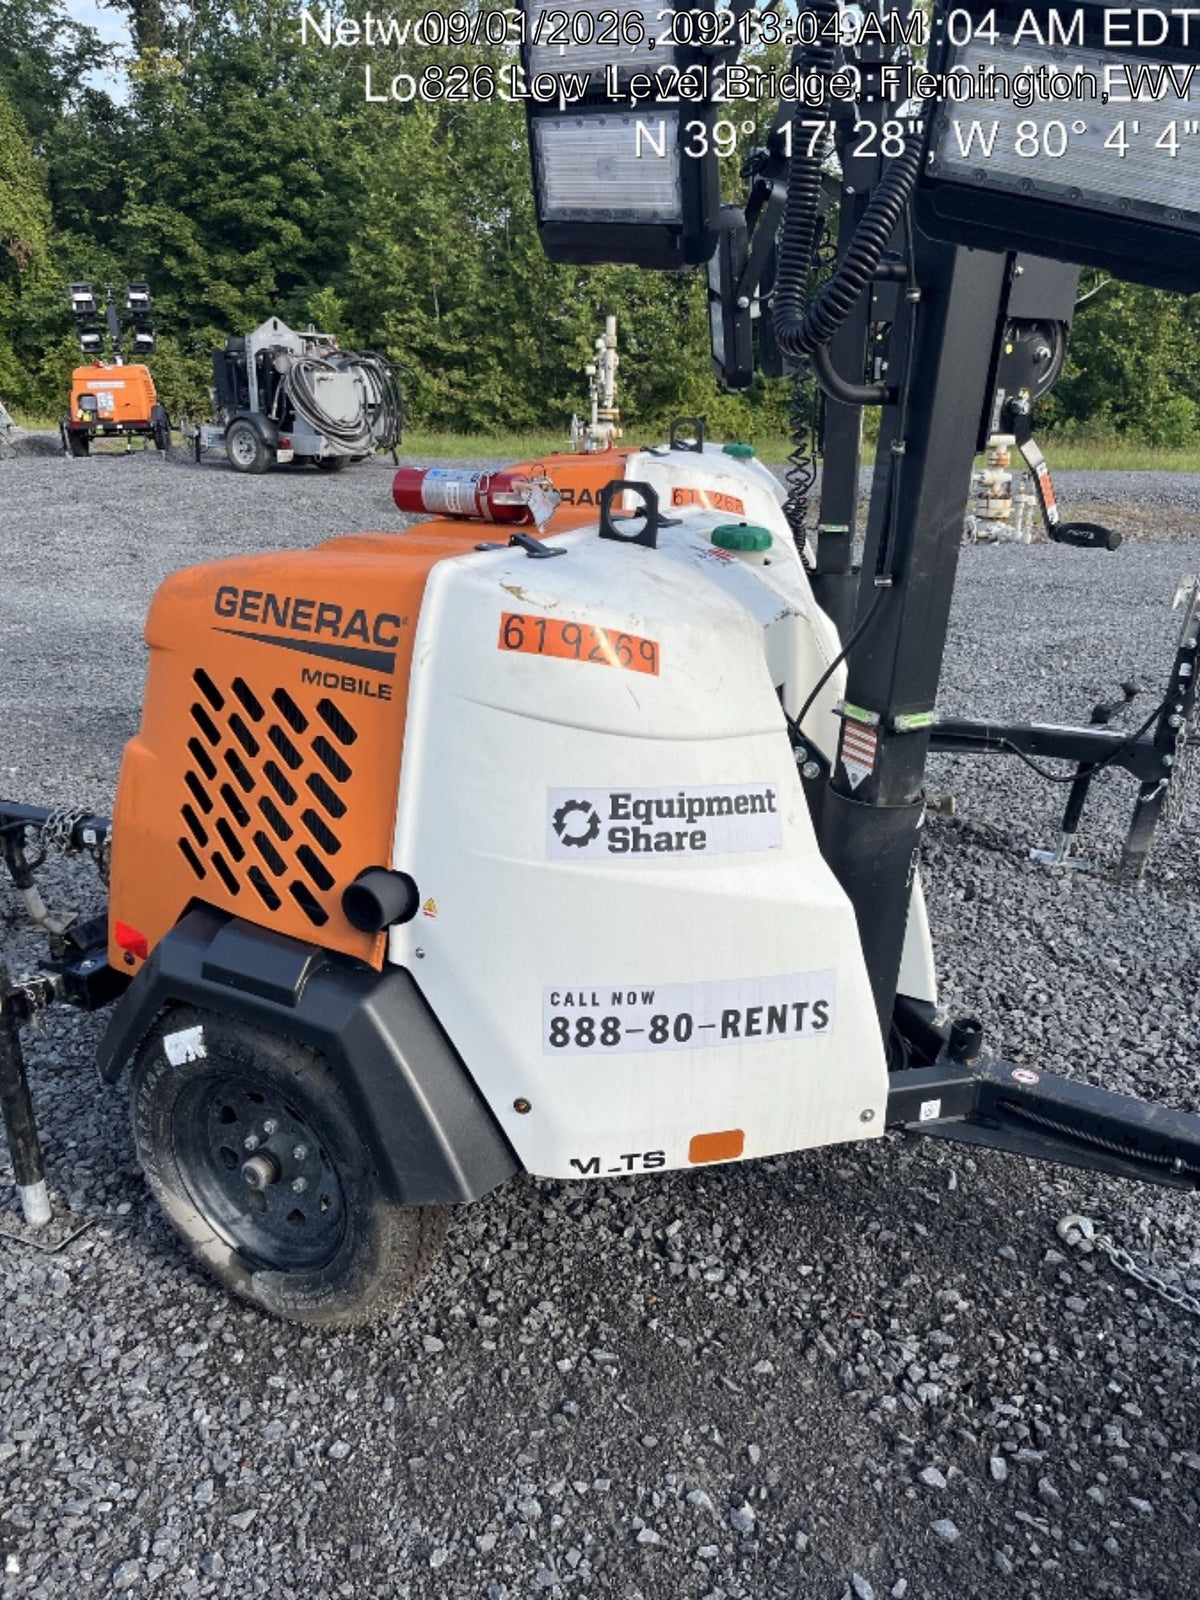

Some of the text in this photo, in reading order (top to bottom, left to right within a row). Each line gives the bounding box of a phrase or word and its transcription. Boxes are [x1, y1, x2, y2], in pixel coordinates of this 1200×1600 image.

[214, 585, 401, 648] GENERAC
[301, 667, 393, 701] MOBILE
[608, 788, 778, 826] Equipment
[607, 826, 707, 854] Share
[549, 990, 656, 1007] CALL NOW
[548, 998, 831, 1049] 888-80-RENTS
